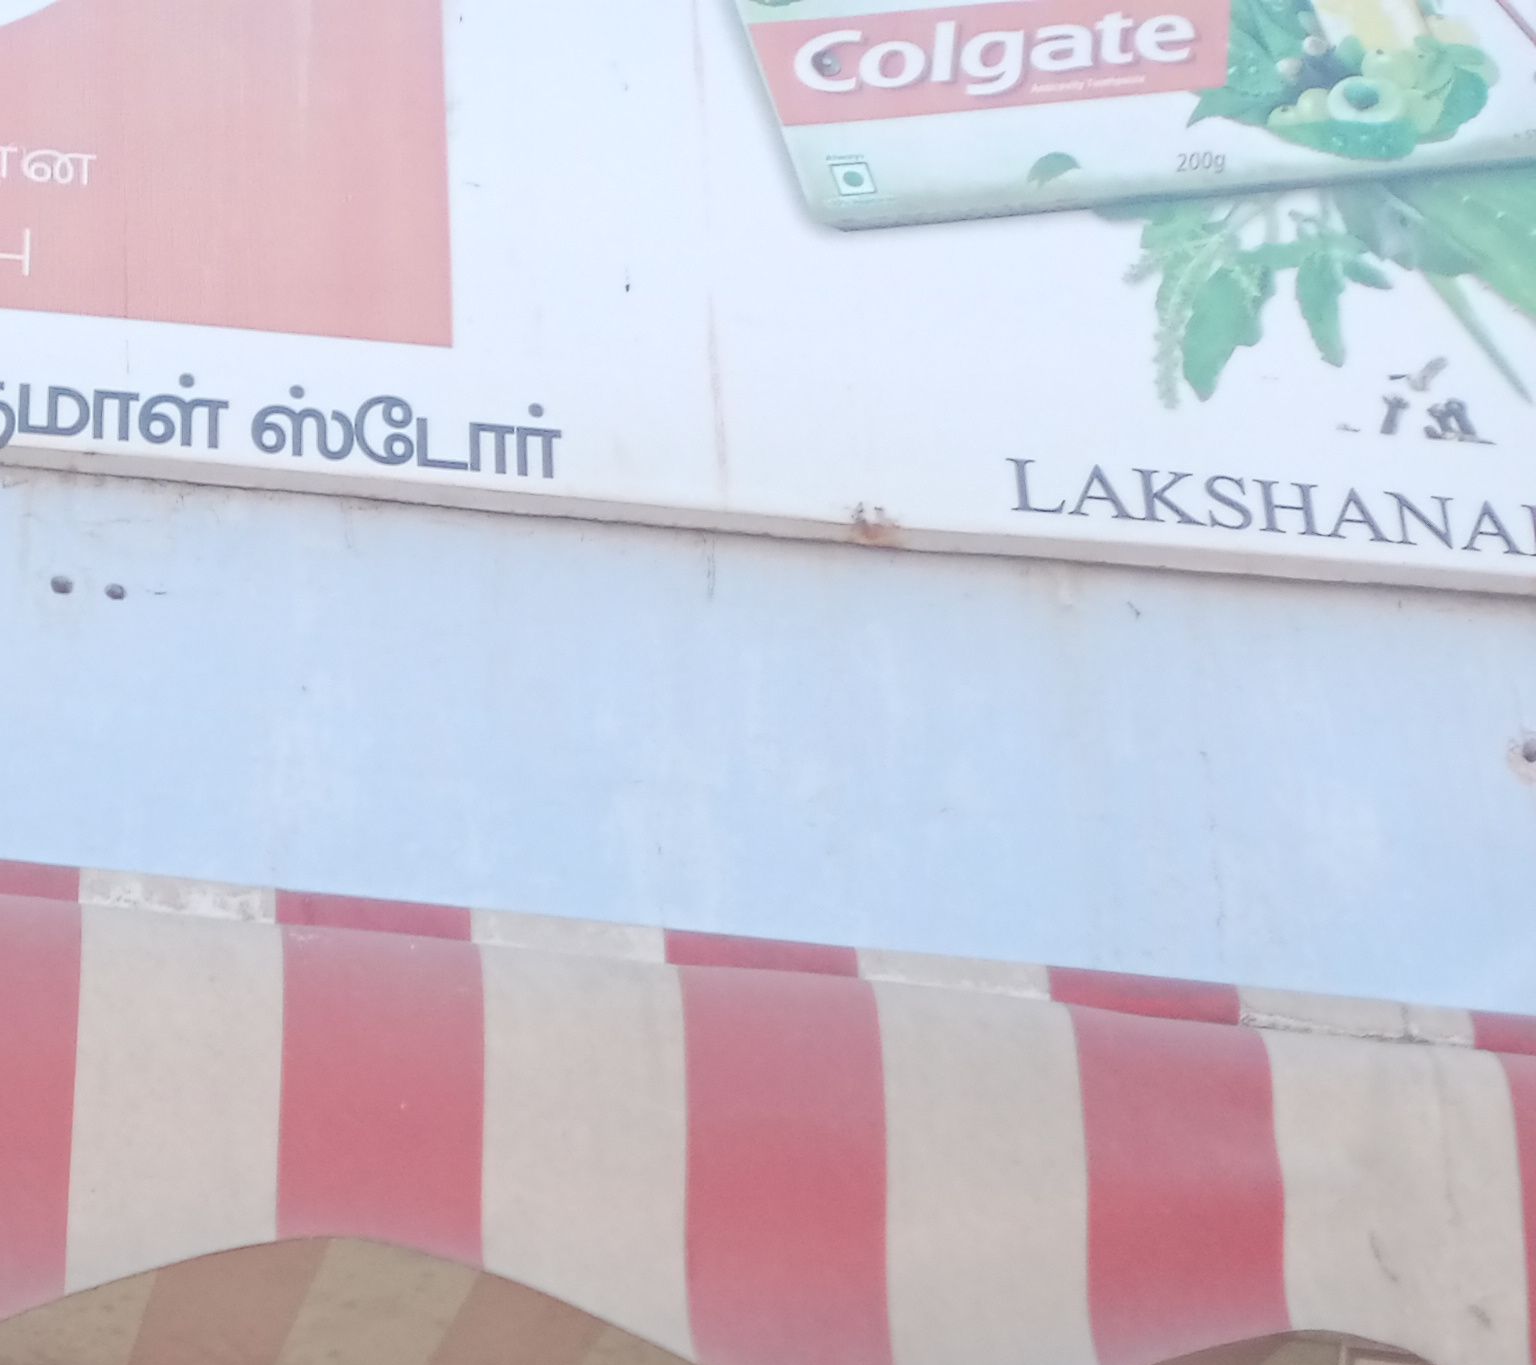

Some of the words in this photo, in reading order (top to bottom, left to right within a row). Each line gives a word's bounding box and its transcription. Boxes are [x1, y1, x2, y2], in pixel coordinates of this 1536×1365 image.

[794, 12, 1197, 97] Colgate
[1175, 151, 1226, 174] 200g
[250, 384, 562, 479] ஸ்டோர்
